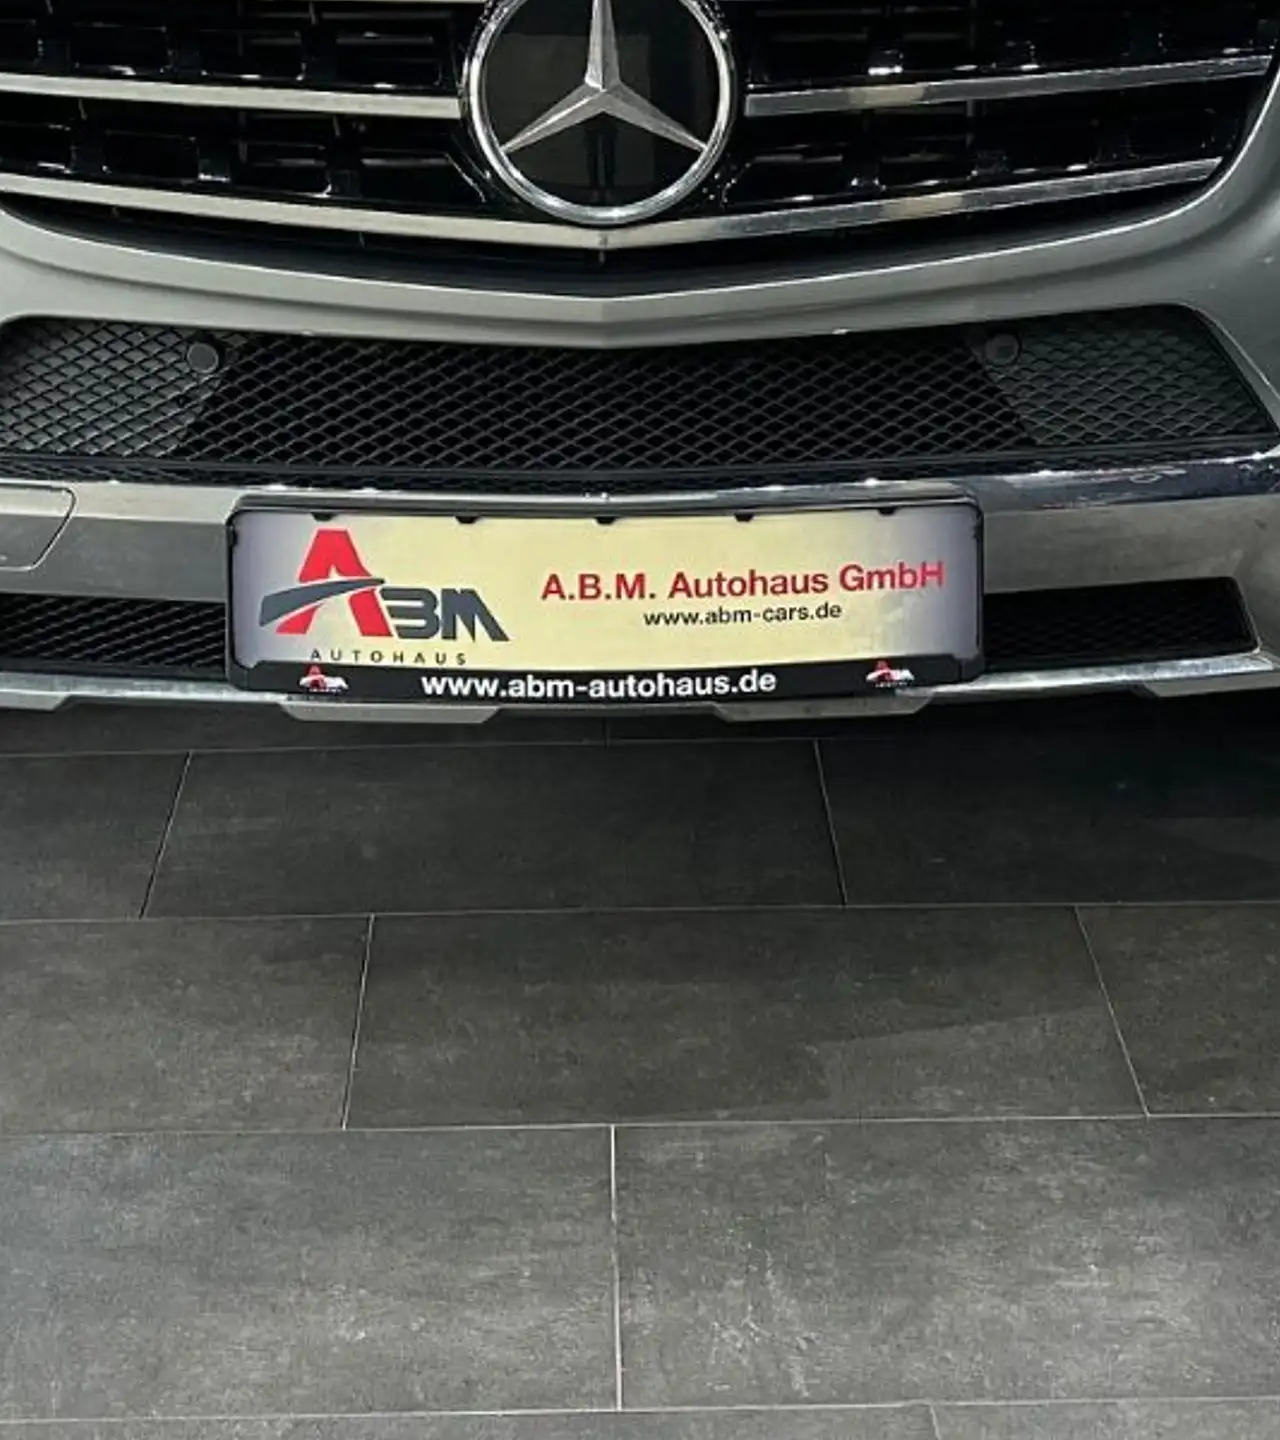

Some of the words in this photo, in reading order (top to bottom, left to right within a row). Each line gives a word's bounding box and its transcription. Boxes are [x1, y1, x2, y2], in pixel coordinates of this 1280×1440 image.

[259, 529, 511, 642] ABM
[541, 572, 656, 600] A.B.M.
[668, 568, 829, 600] Autohaus
[839, 561, 945, 592] GmbH
[643, 601, 842, 626] www.abm-cars.de
[310, 648, 466, 666] AUTOHAUS
[421, 667, 777, 698] www.abm-autohaus.de
